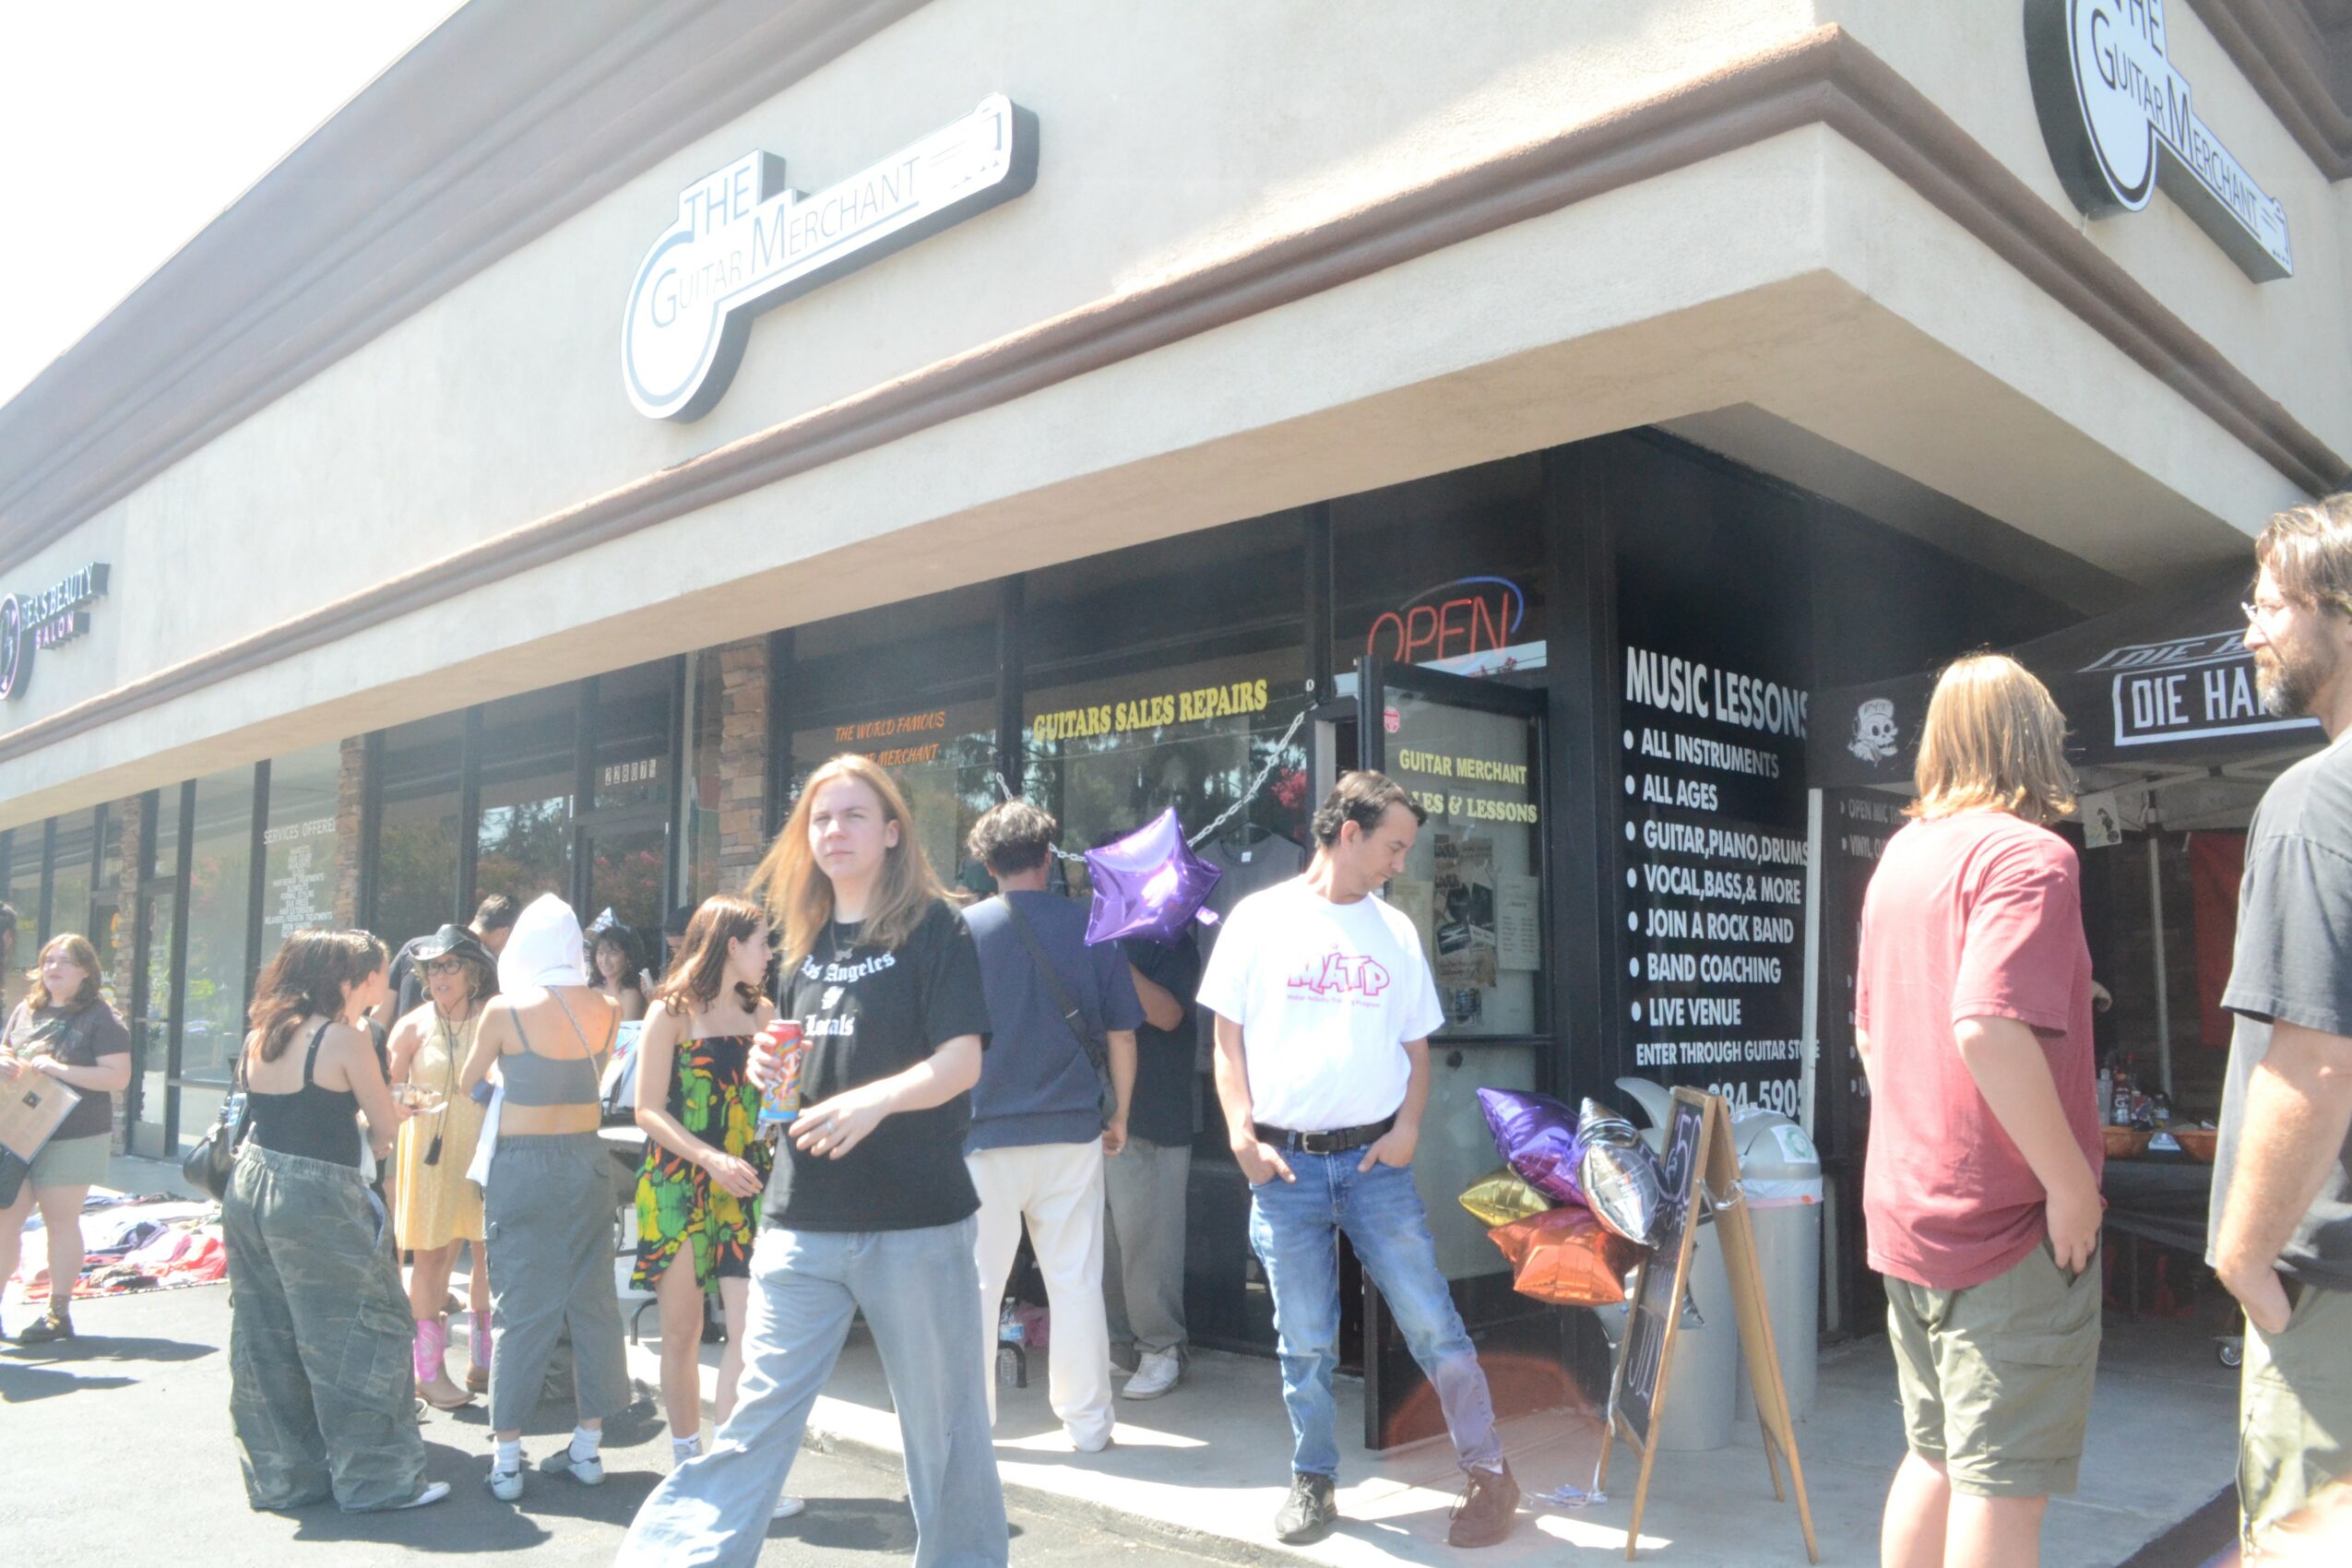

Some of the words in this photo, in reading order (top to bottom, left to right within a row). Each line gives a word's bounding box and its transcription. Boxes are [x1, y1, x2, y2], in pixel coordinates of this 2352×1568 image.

[2113, 0, 2163, 57] HE
[2091, 8, 2166, 132] GUITAR
[2167, 75, 2258, 230] MERCHANT
[683, 164, 751, 235] THE
[651, 250, 742, 328] GUITAR
[751, 156, 921, 276] MERCHANT
[49, 562, 94, 616] BEAUTY
[35, 612, 74, 650] SALON
[1367, 592, 1510, 664] OPEN
[1033, 704, 1112, 742] GUITARS
[1115, 694, 1175, 731] SALES
[1179, 679, 1268, 722] REPAIRS
[1626, 646, 1708, 719] MUSIC
[1714, 668, 1809, 740] LESSONS
[2132, 674, 2189, 729] DIE
[835, 725, 854, 742] THE
[857, 719, 895, 739] WORLD
[897, 711, 945, 732] FAMOUS
[878, 742, 940, 767] MERCHANT
[1399, 749, 1452, 777] GUITAR
[1456, 757, 1527, 784] MERCHANT
[1641, 728, 1671, 759] ALL
[1674, 733, 1780, 779] INSTRUMENTS
[1448, 795, 1462, 815] &
[1467, 797, 1538, 824] LESSONS
[1643, 774, 1673, 804] ALL
[1676, 778, 1718, 812] AGES
[263, 825, 299, 844] SERVICES
[1761, 876, 1801, 905] MORE
[1645, 909, 1687, 939] JOIN
[1691, 911, 1705, 940] A
[1707, 912, 1750, 942] ROCK
[1752, 916, 1794, 944] BAND
[824, 950, 897, 982] Angeles
[1647, 953, 1696, 981] BAND
[1700, 955, 1781, 984] COACHING
[805, 1014, 855, 1036] Locals
[1649, 998, 1684, 1026] LIVE
[1688, 998, 1741, 1026] VENUE
[1636, 1042, 1677, 1066] ENTER
[1680, 1040, 1741, 1064] THROUGH
[1744, 1039, 1786, 1061] GUITAR
[1708, 1078, 1801, 1118] 84-590
